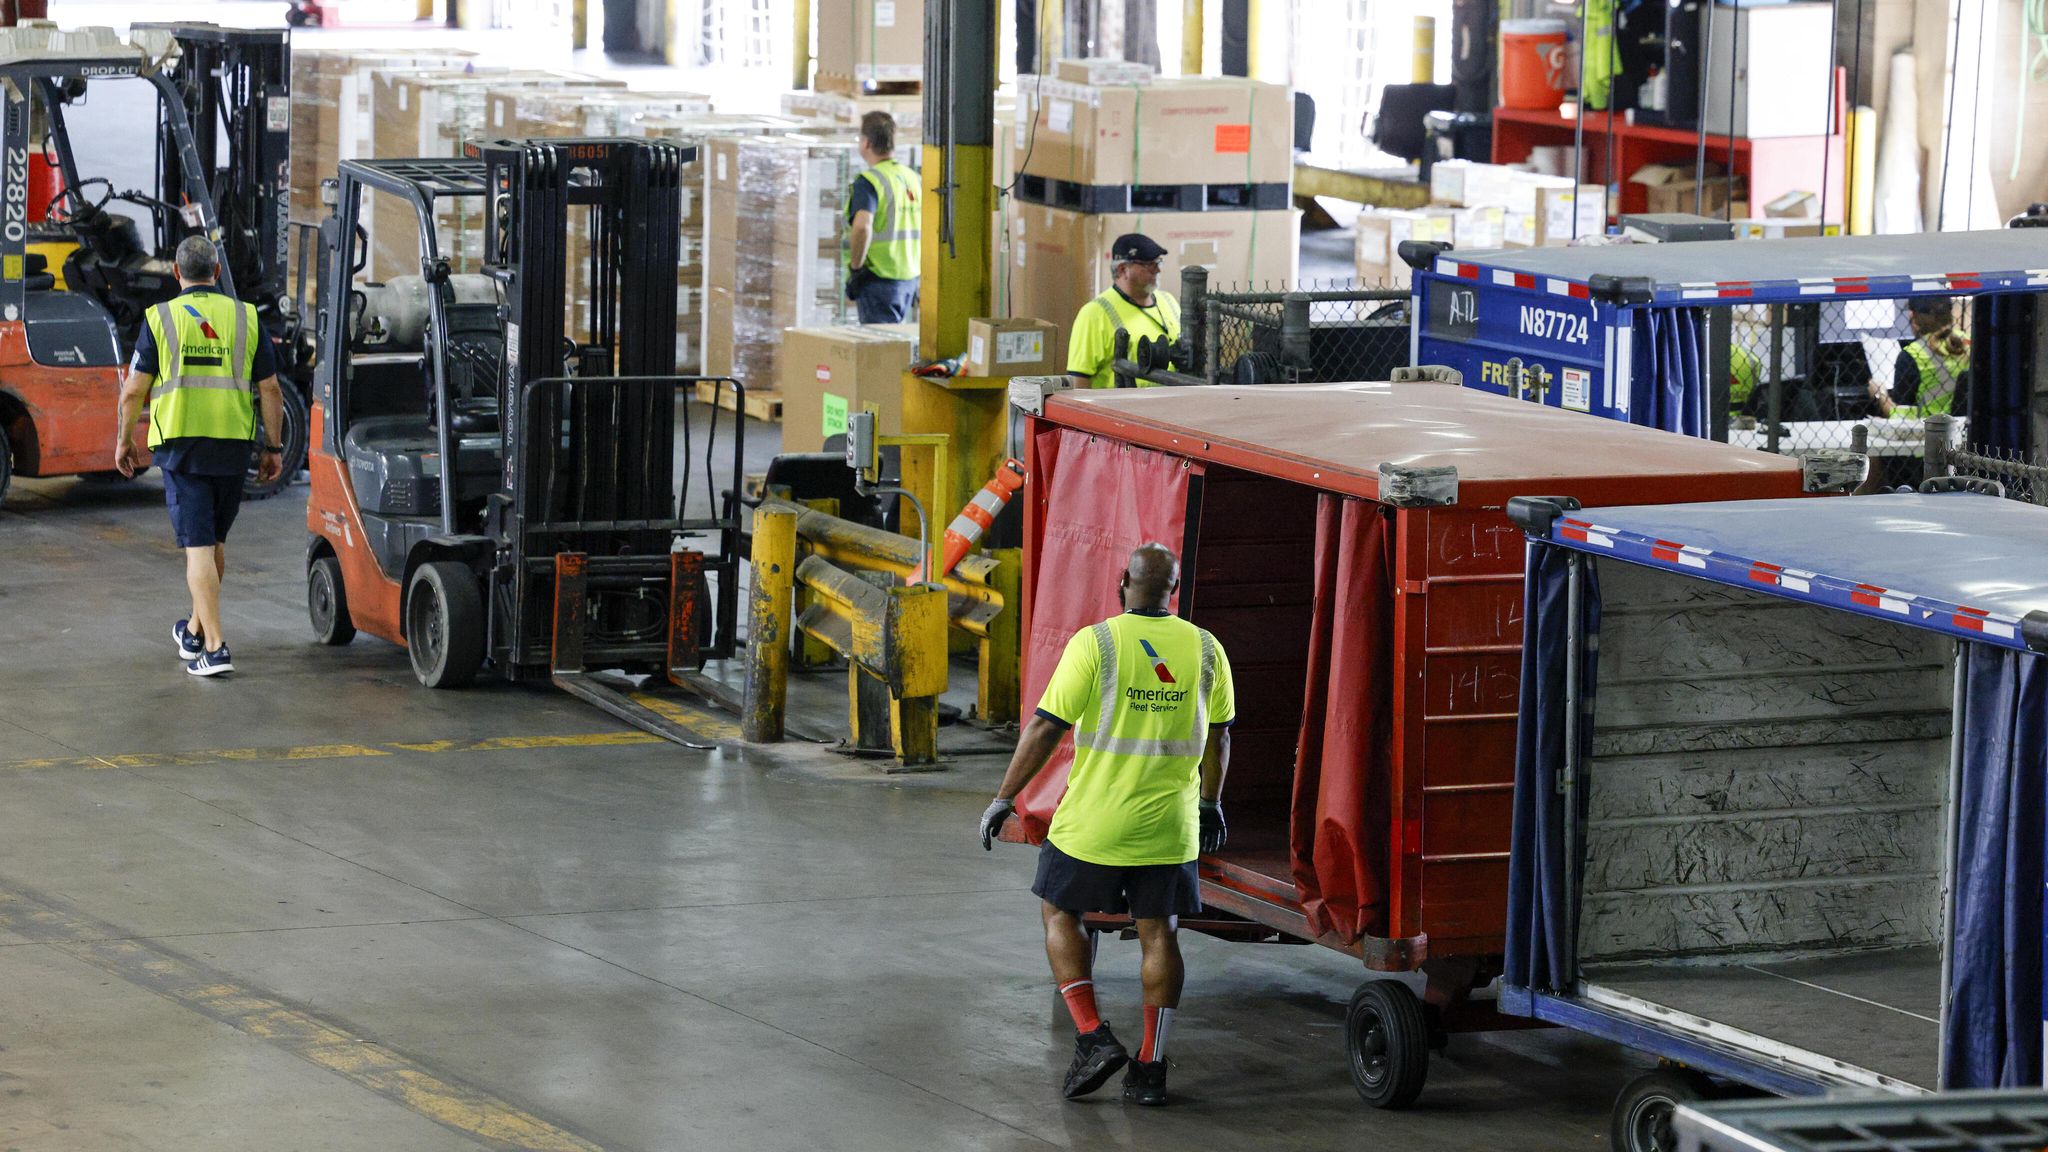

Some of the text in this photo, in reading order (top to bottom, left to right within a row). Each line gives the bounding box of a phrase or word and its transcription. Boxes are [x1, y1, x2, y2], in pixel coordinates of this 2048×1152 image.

[81, 65, 115, 76] DROP
[5, 147, 27, 242] 22820
[276, 190, 289, 264] TOYOTA
[1449, 290, 1479, 326] ATL
[1519, 305, 1589, 345] N87724
[181, 344, 230, 355] American
[1481, 361, 1553, 394] FREGT
[506, 364, 516, 446] TOYOTA
[358, 460, 375, 472] TOYOTA
[1150, 703, 1178, 713] Service
